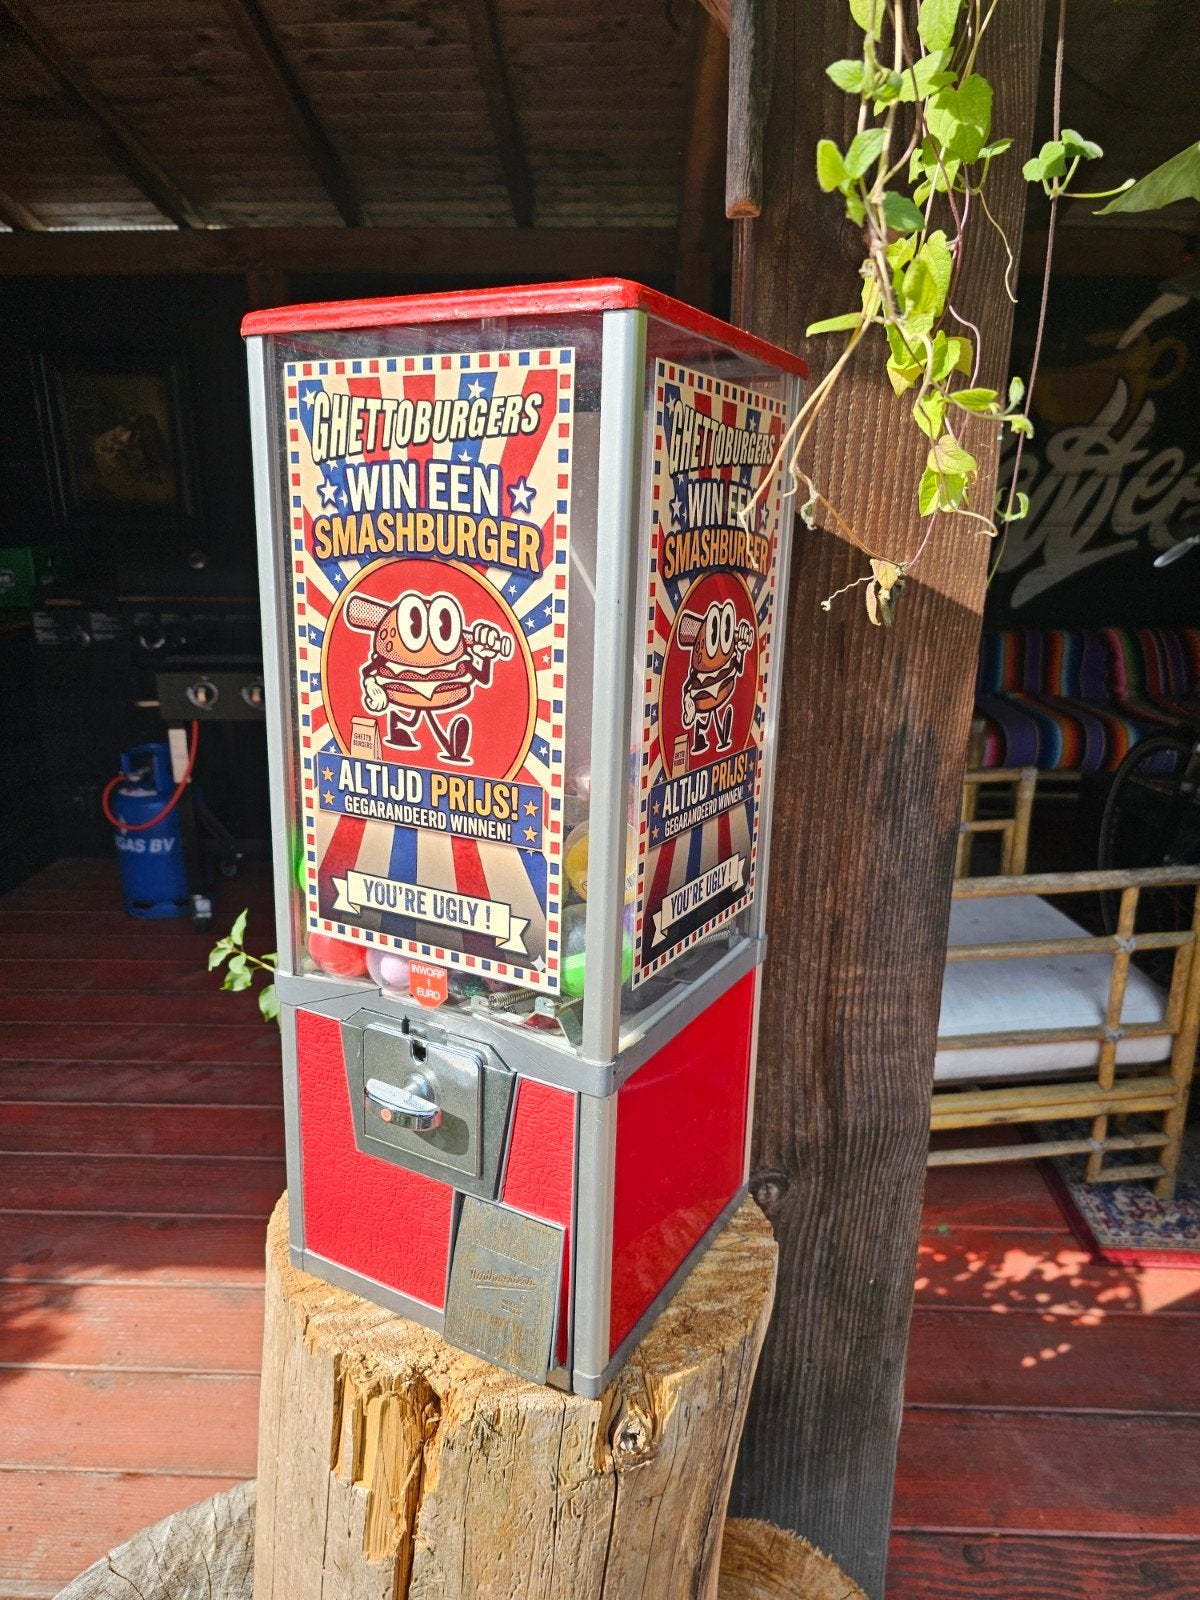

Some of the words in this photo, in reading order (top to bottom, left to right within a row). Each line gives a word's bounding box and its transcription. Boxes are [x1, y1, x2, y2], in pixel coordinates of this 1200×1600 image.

[312, 391, 543, 463] GHETTOBURGERS
[669, 400, 776, 477] GHETTOBURGERS
[346, 463, 417, 512] WIN
[428, 462, 500, 517] EEN
[687, 481, 723, 528] WIN
[727, 484, 757, 532] EEN
[314, 512, 542, 573] SMASHBURGER
[663, 528, 770, 579] SMASHBURGER
[338, 759, 423, 804] ALTIJD
[431, 774, 520, 822] PRIJS!
[662, 769, 708, 819] ALTIJD
[710, 752, 748, 795] PRIJS!
[344, 795, 447, 831] GEGARANDEERD
[450, 814, 512, 842] WINNEN!
[664, 797, 718, 838] GEGARANDEERD
[718, 787, 744, 814] WINNEN!
[149, 836, 177, 854] BV
[362, 878, 427, 917] YOU'RE
[432, 895, 479, 927] UGLY
[670, 878, 704, 920] YOU'RE
[706, 865, 728, 897] UGLY
[411, 963, 445, 979] INWORP
[416, 986, 441, 1000] EURO
[426, 978, 432, 988] 1
